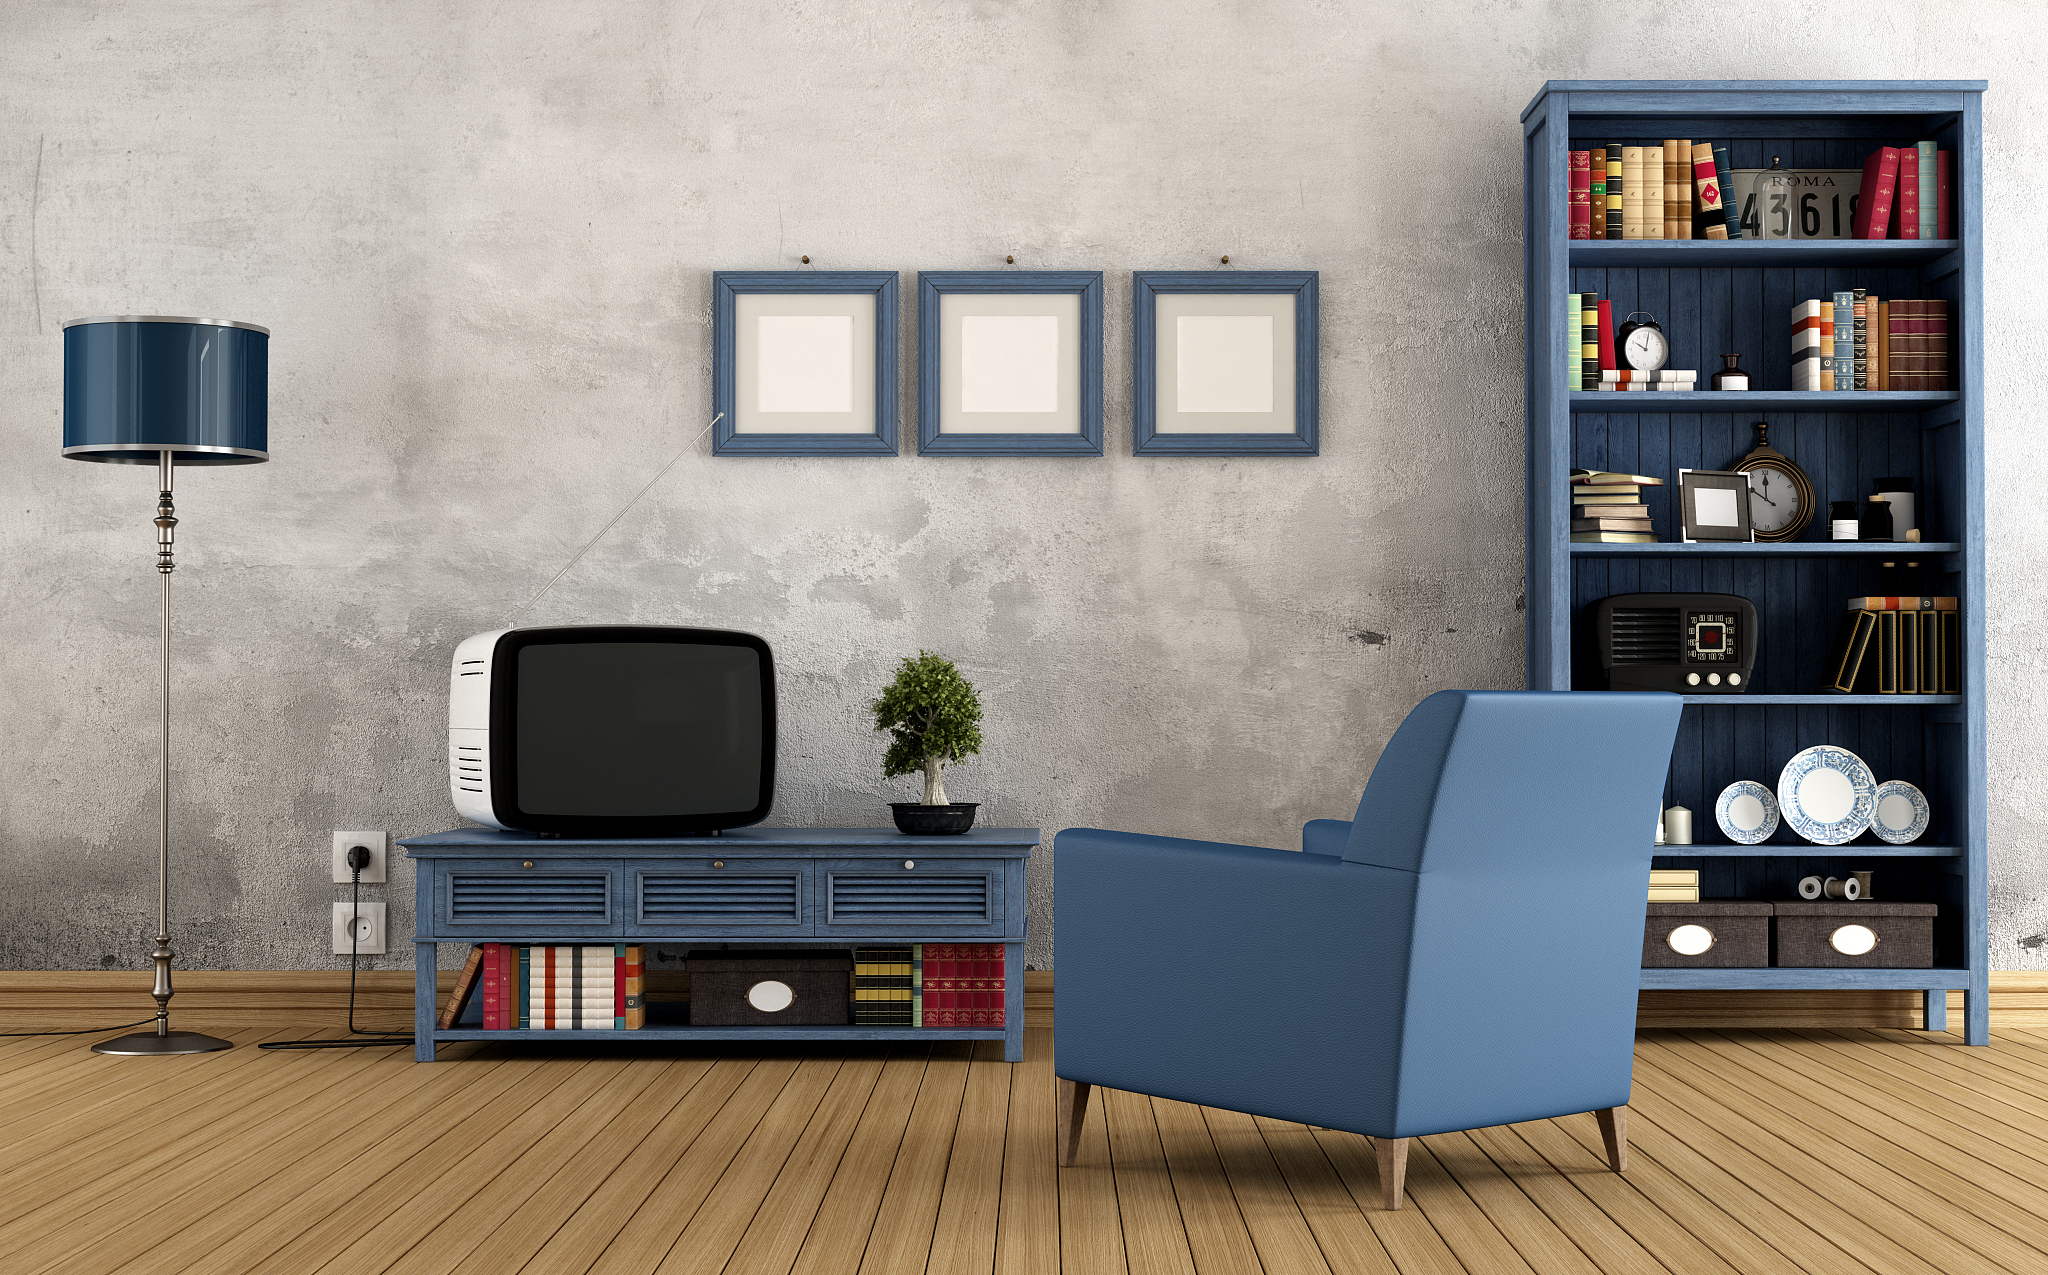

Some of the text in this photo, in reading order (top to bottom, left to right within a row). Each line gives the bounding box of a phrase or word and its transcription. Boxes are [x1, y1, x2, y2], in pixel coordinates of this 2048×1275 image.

[1772, 177, 1836, 187] ROMA
[1715, 614, 1724, 622] 110
[1725, 617, 1734, 625] 130
[1708, 653, 1717, 661] 100
